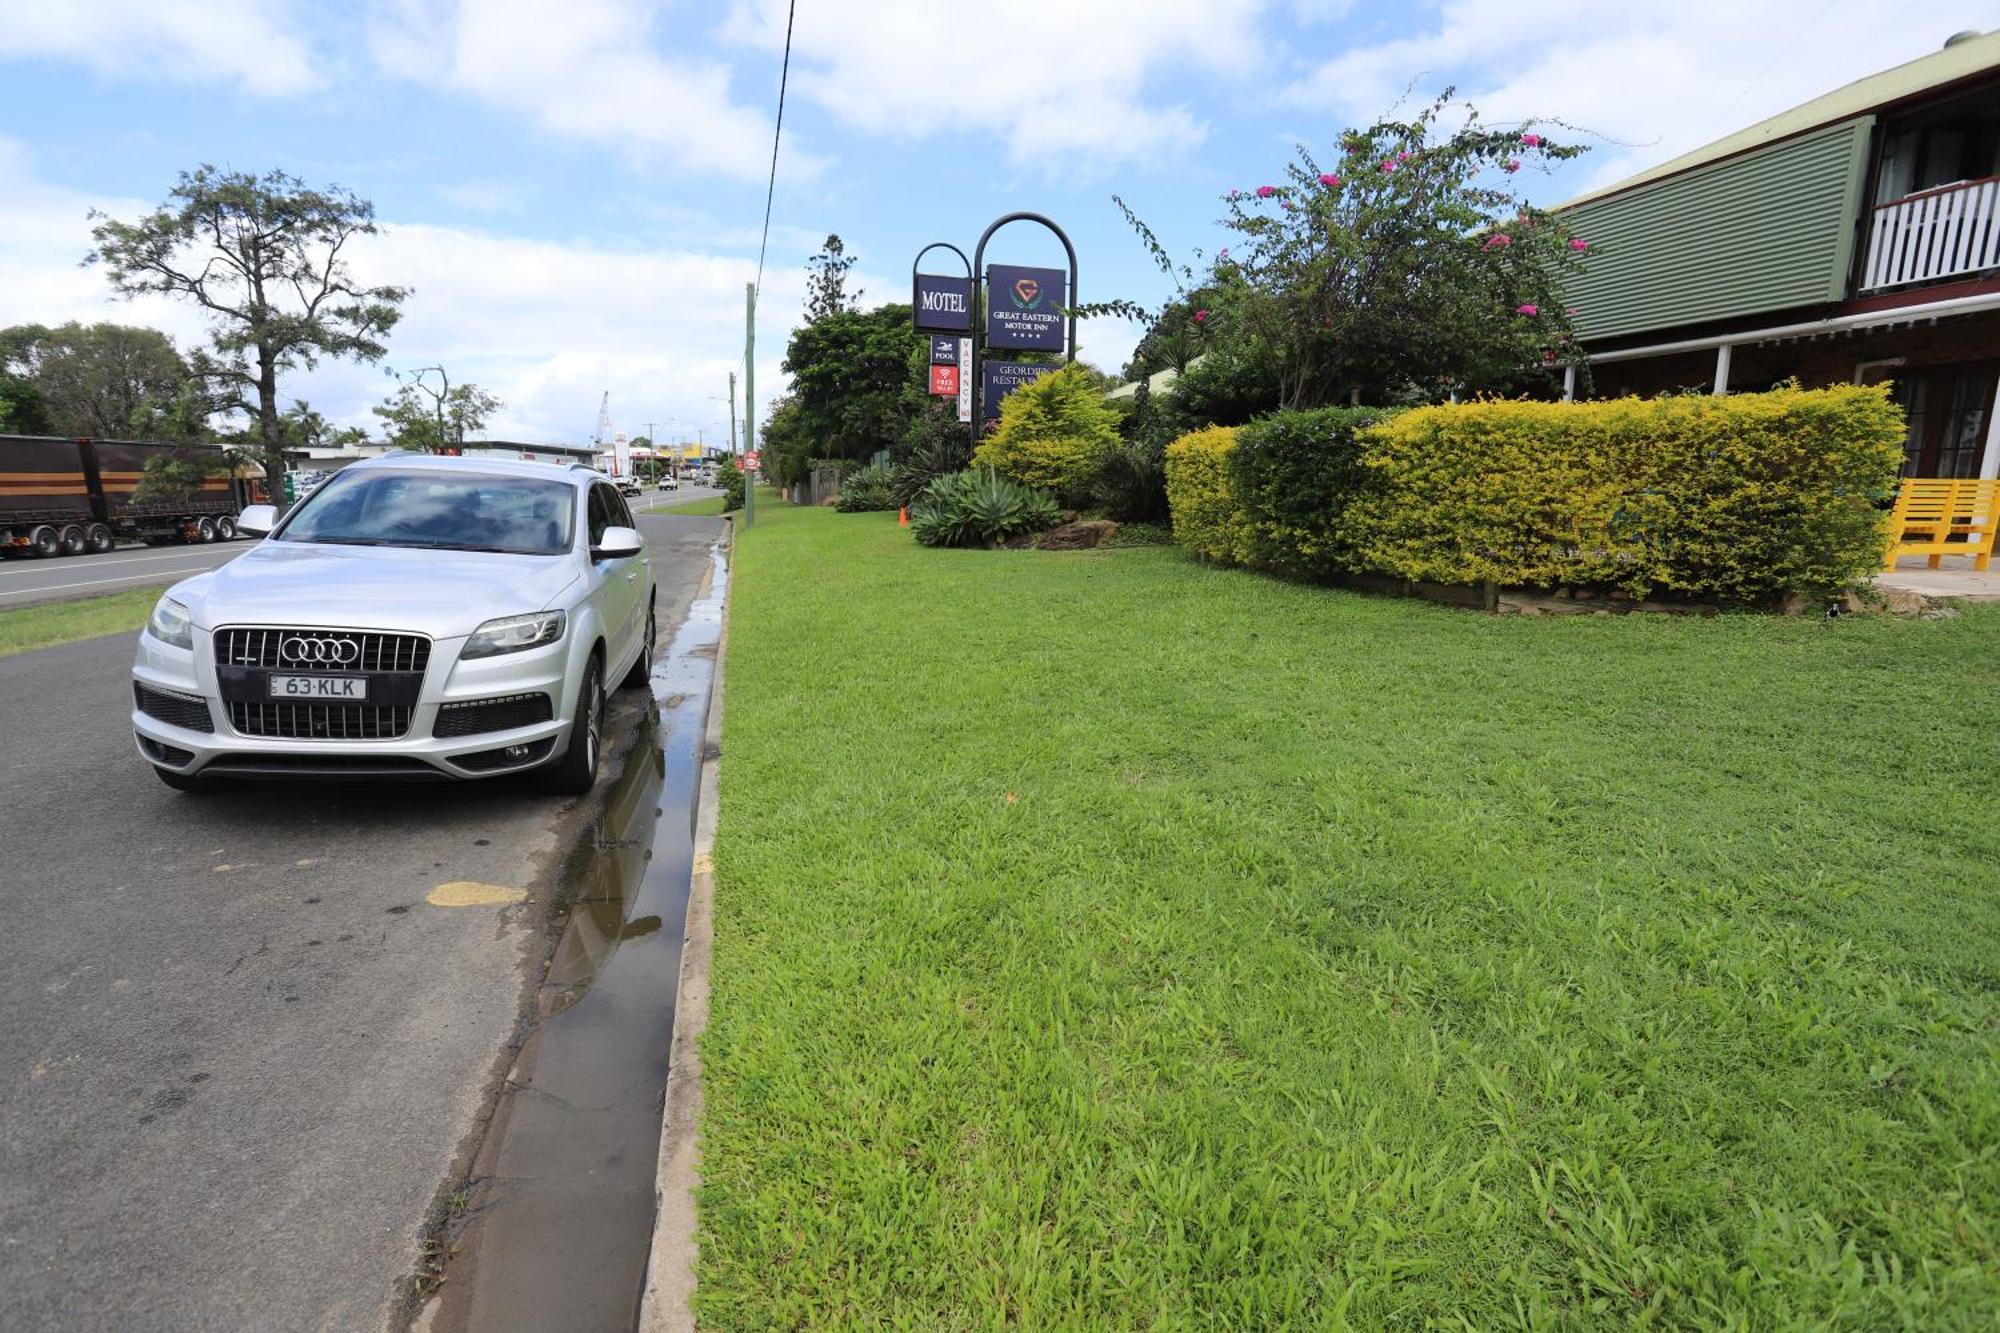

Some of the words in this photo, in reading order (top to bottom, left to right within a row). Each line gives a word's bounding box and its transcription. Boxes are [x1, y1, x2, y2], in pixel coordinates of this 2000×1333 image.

[922, 291, 966, 313] MOTEL
[993, 311, 1021, 320] GREAT
[1022, 313, 1060, 322] EASTERN
[1004, 322, 1032, 330] MOTOR
[1034, 323, 1049, 331] INN
[935, 353, 955, 361] POOL
